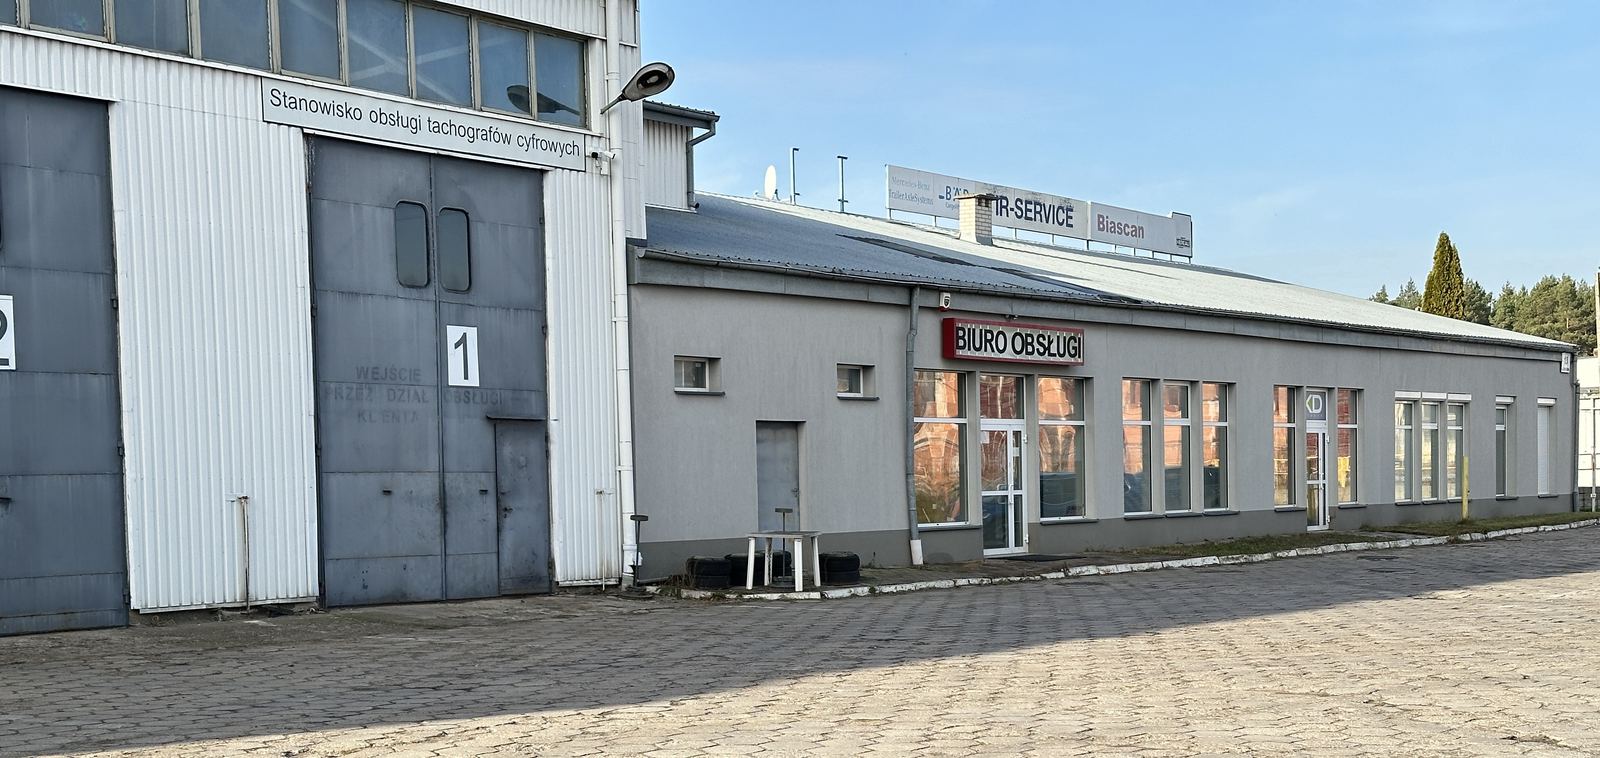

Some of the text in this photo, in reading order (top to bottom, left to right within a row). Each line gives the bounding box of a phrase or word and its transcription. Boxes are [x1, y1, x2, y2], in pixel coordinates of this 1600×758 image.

[270, 88, 581, 158] Stanowisko obsługi tachografów cyfrowych
[994, 195, 1074, 229] IR-SERVICE
[1097, 213, 1145, 239] Biascan
[454, 332, 469, 380] 1
[955, 326, 1082, 359] BIURO OBSŁUGI
[354, 364, 421, 382] WEJŚCIE
[388, 387, 430, 404] DZIAŁ
[357, 410, 418, 424] KLENTA
